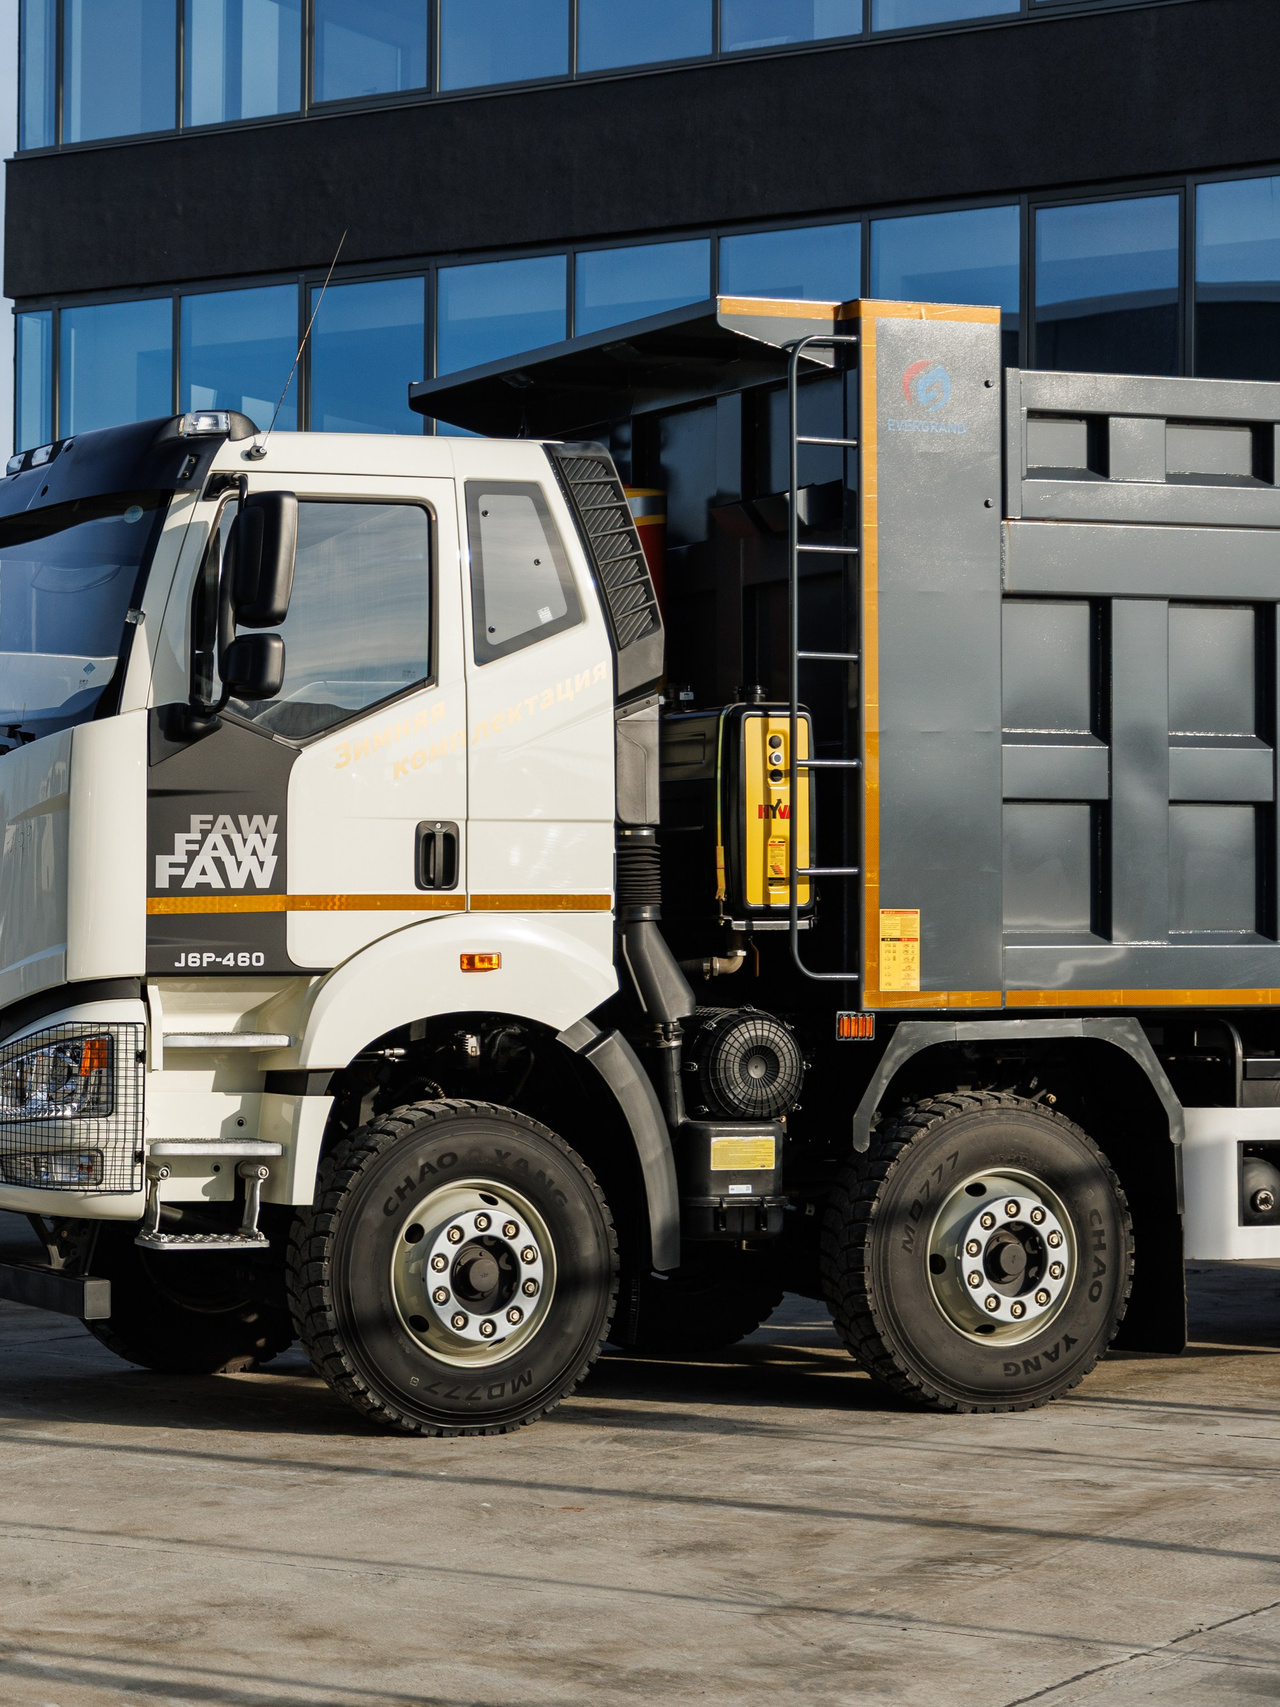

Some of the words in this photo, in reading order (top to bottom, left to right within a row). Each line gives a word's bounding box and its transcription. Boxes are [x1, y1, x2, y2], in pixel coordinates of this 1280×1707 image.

[334, 701, 446, 769] Зимняя
[392, 660, 607, 780] комплектация
[174, 833, 279, 862] FAW
[190, 814, 279, 838] FAW
[155, 855, 279, 889] FAW
[174, 952, 265, 968] J6P-460
[382, 1151, 459, 1218] CHAO
[493, 1148, 569, 1208] YANG
[900, 1150, 960, 1255] MD777
[1087, 1207, 1108, 1304] CHAO
[1002, 1333, 1079, 1378] YANG
[422, 1366, 533, 1400] MD777
